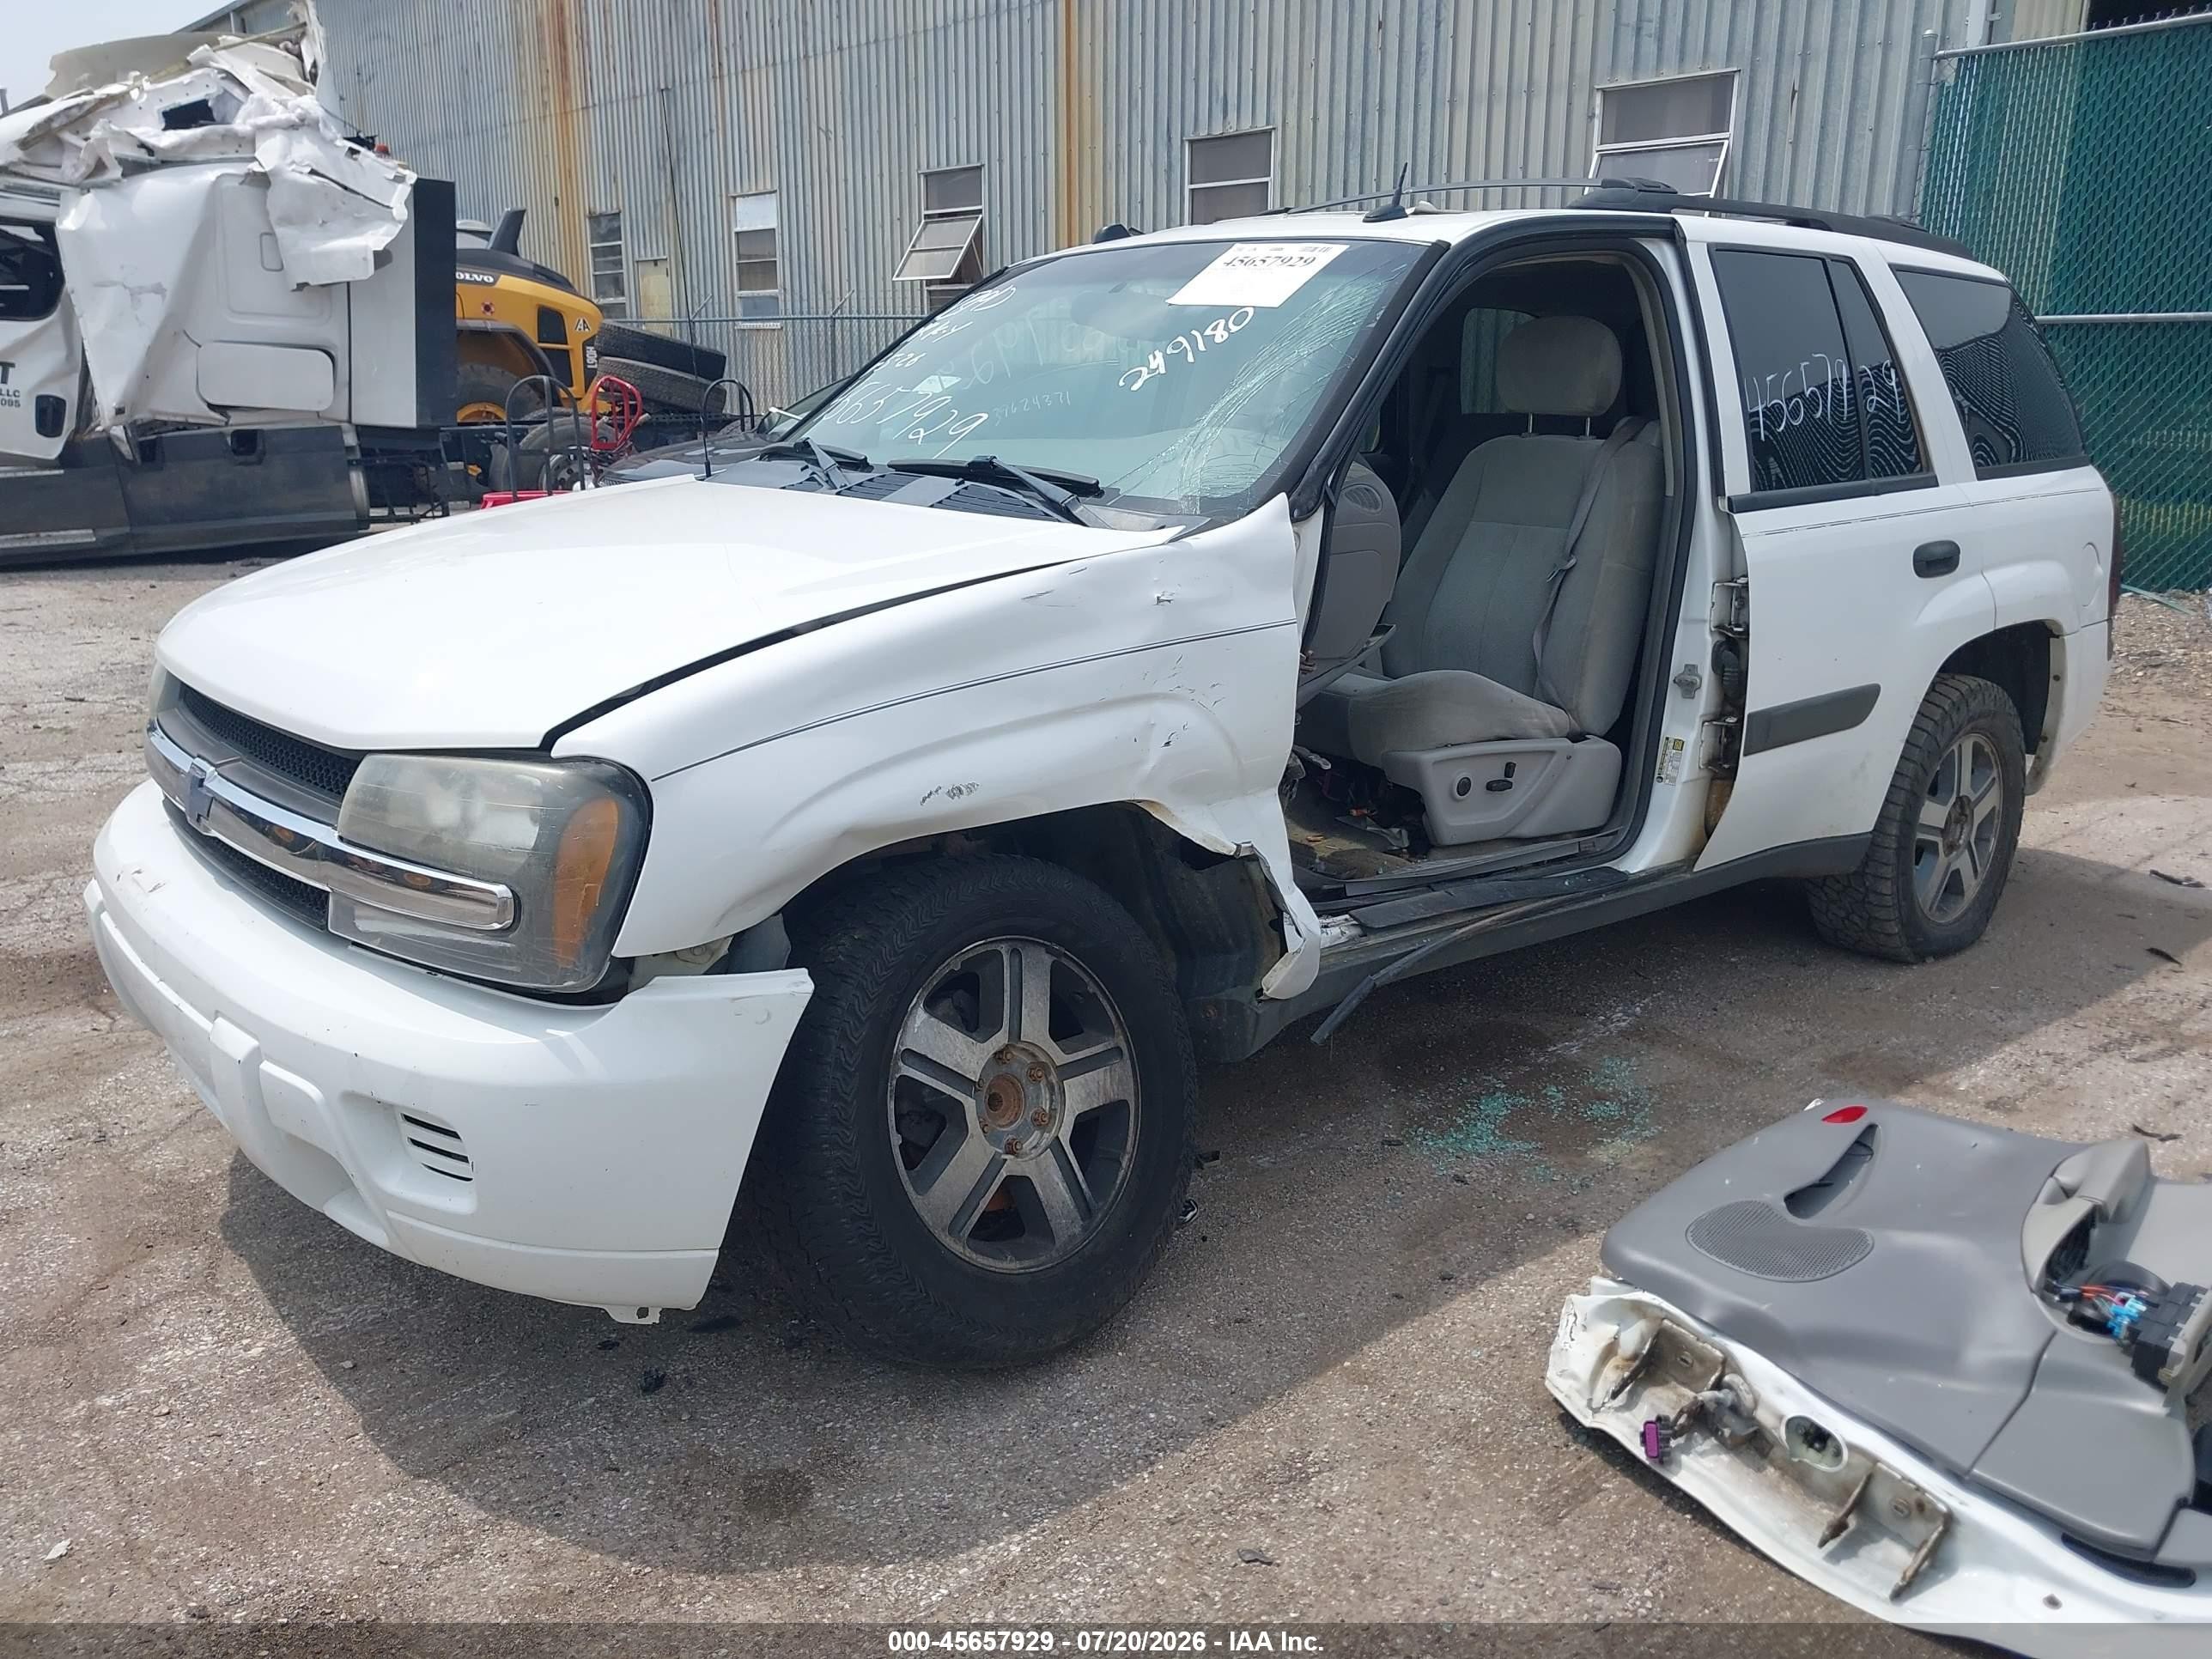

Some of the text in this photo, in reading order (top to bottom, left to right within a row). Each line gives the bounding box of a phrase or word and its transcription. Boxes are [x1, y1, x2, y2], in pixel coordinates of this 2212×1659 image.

[1223, 256, 1316, 268] 45657929
[455, 270, 495, 283] OLVO
[586, 346, 599, 368] L90H
[1118, 307, 1255, 392] 249180
